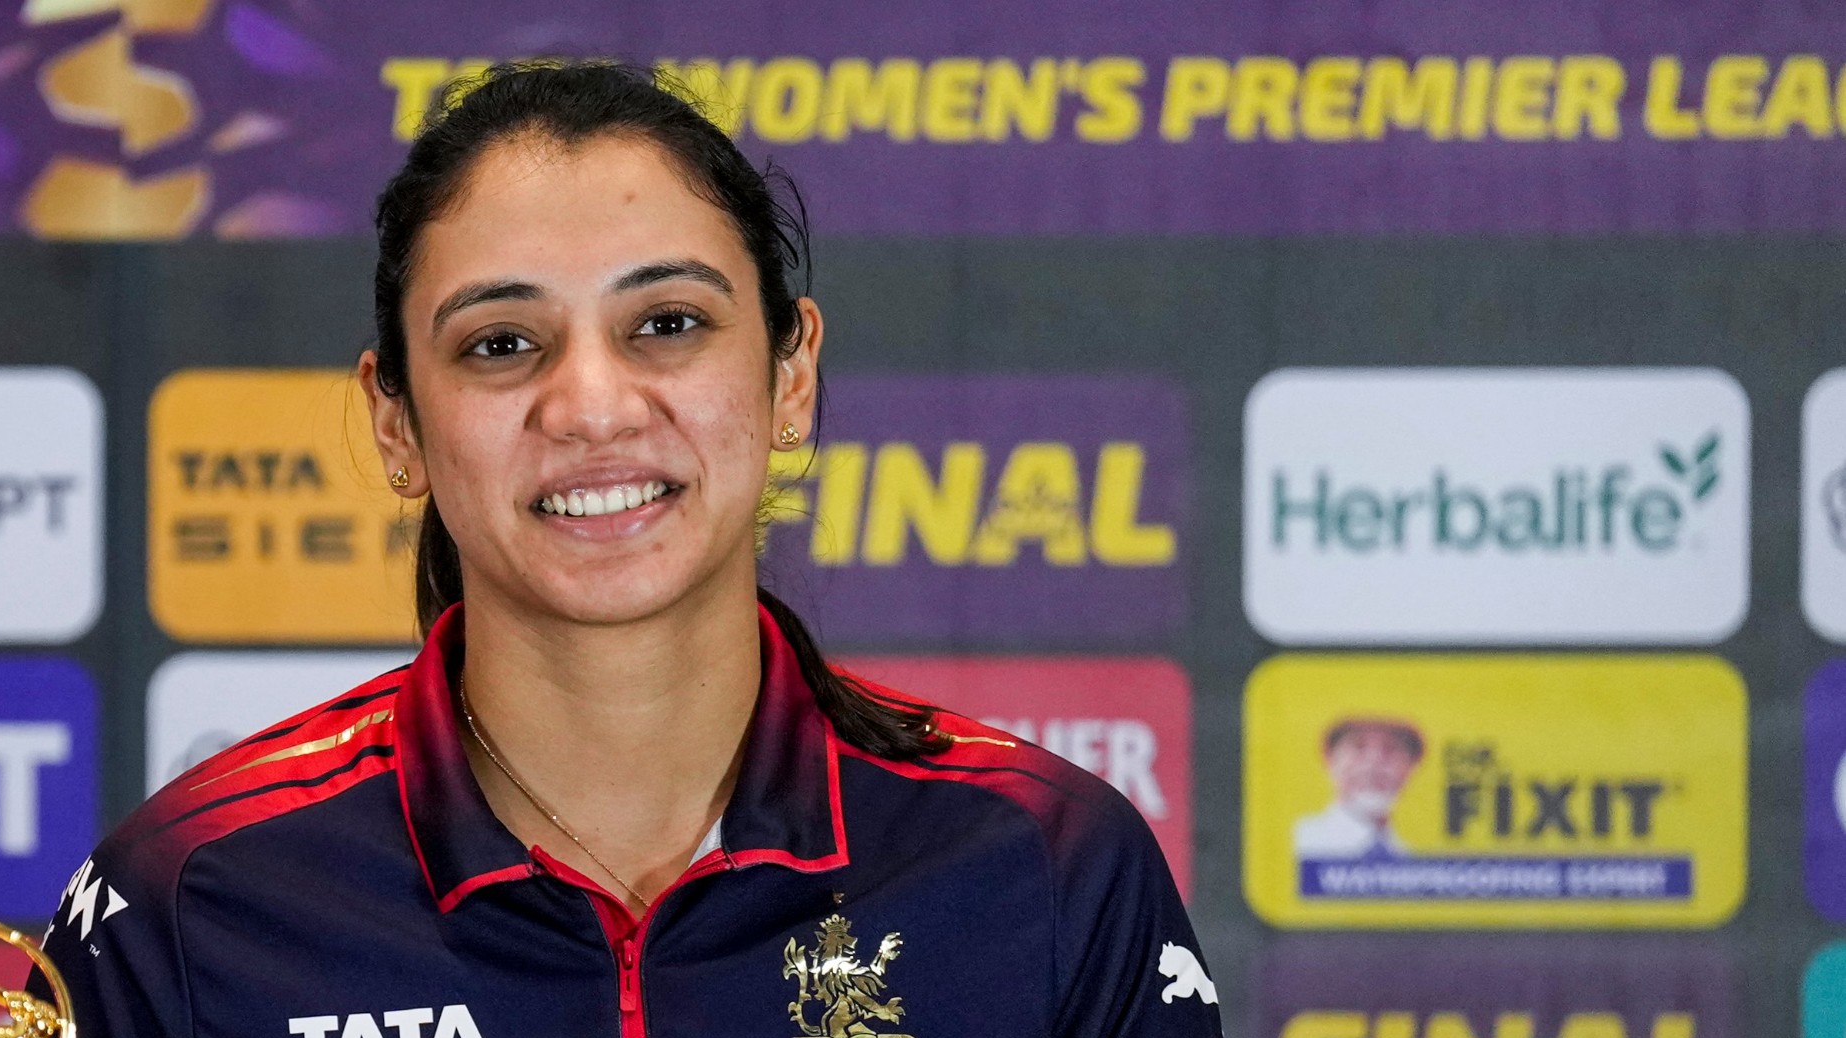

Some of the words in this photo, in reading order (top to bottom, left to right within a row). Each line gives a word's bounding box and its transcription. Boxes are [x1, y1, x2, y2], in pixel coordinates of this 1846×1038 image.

[1160, 55, 1626, 141] PREMIER
[1643, 54, 1846, 141] LEA
[172, 450, 326, 492] TATA
[1268, 468, 1683, 554] Herbalife
[1444, 775, 1666, 841] FIXIT
